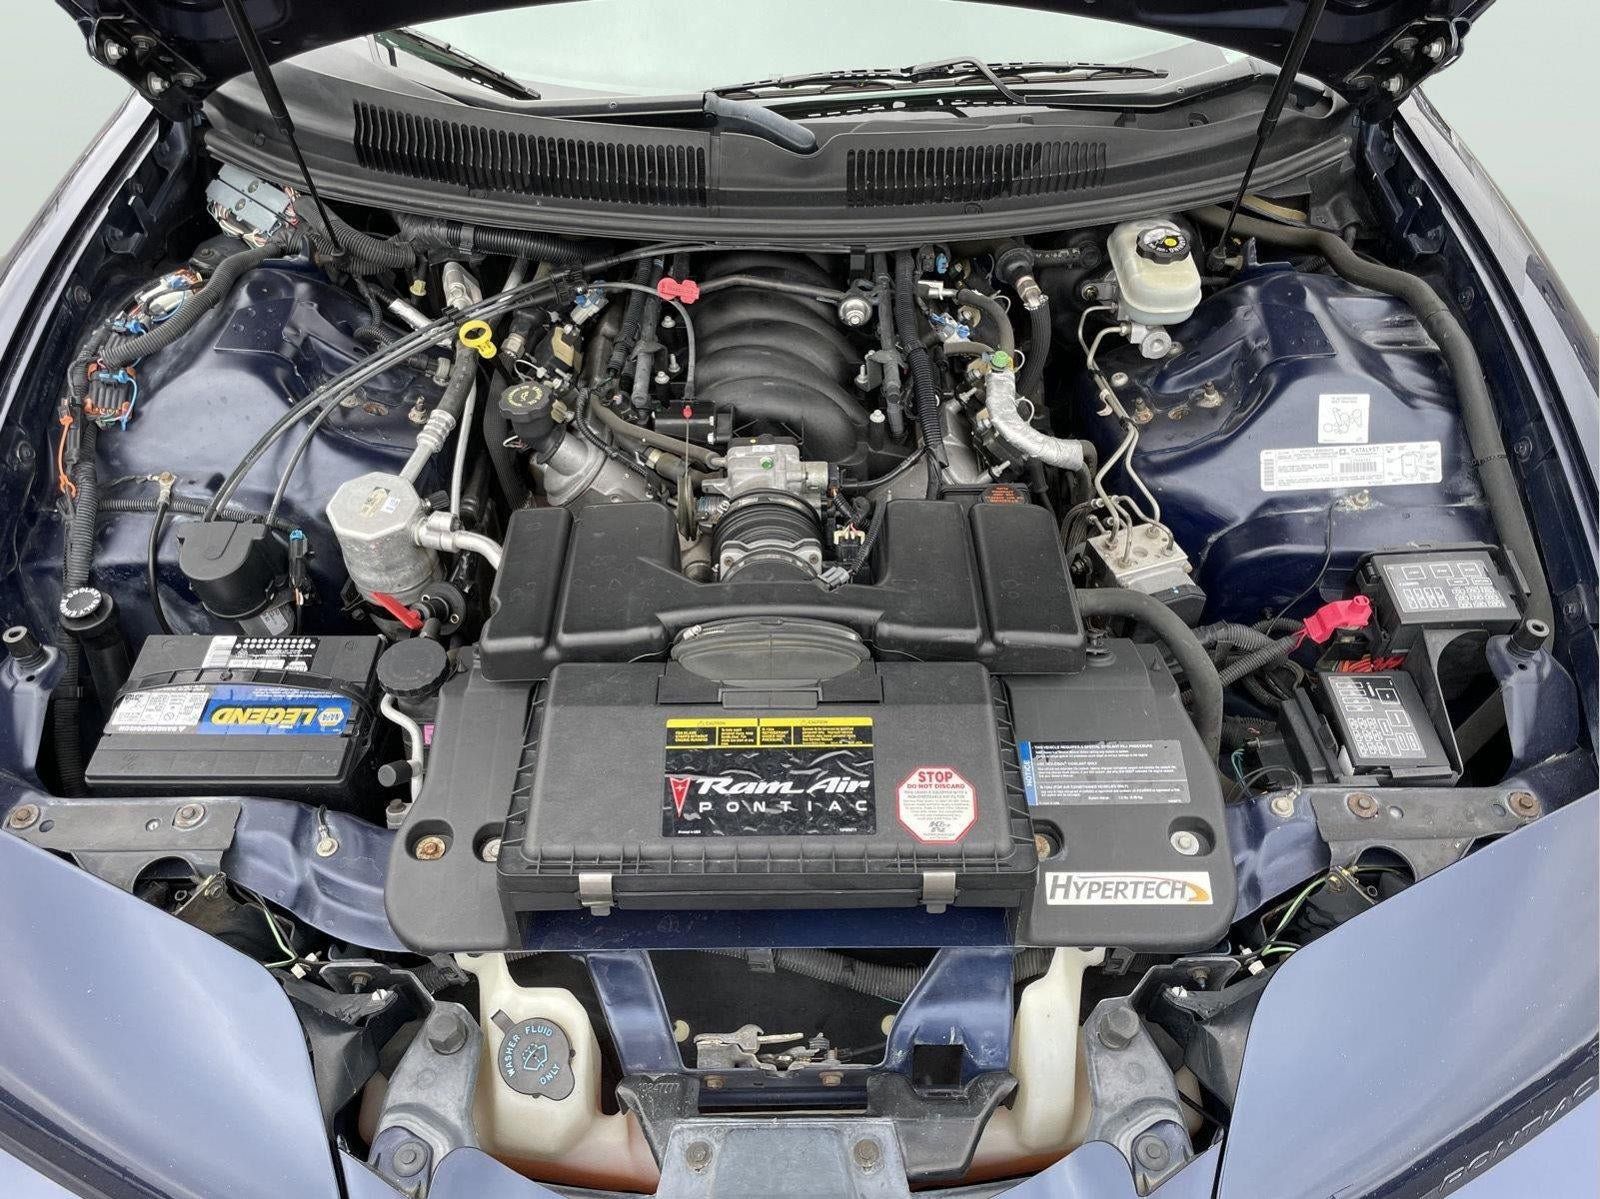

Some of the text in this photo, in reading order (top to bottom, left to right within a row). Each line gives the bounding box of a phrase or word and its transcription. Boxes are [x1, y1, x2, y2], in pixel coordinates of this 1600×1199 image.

[1351, 446, 1380, 454] CATALYST
[211, 706, 318, 725] LEGEND
[918, 771, 953, 783] STOP
[1022, 760, 1033, 787] NOTICE
[696, 777, 870, 798] Ram Air
[699, 801, 868, 813] PONTIAC
[1049, 874, 1188, 900] HYPERTECH
[504, 1025, 560, 1085] WASHER FLUID ONLY
